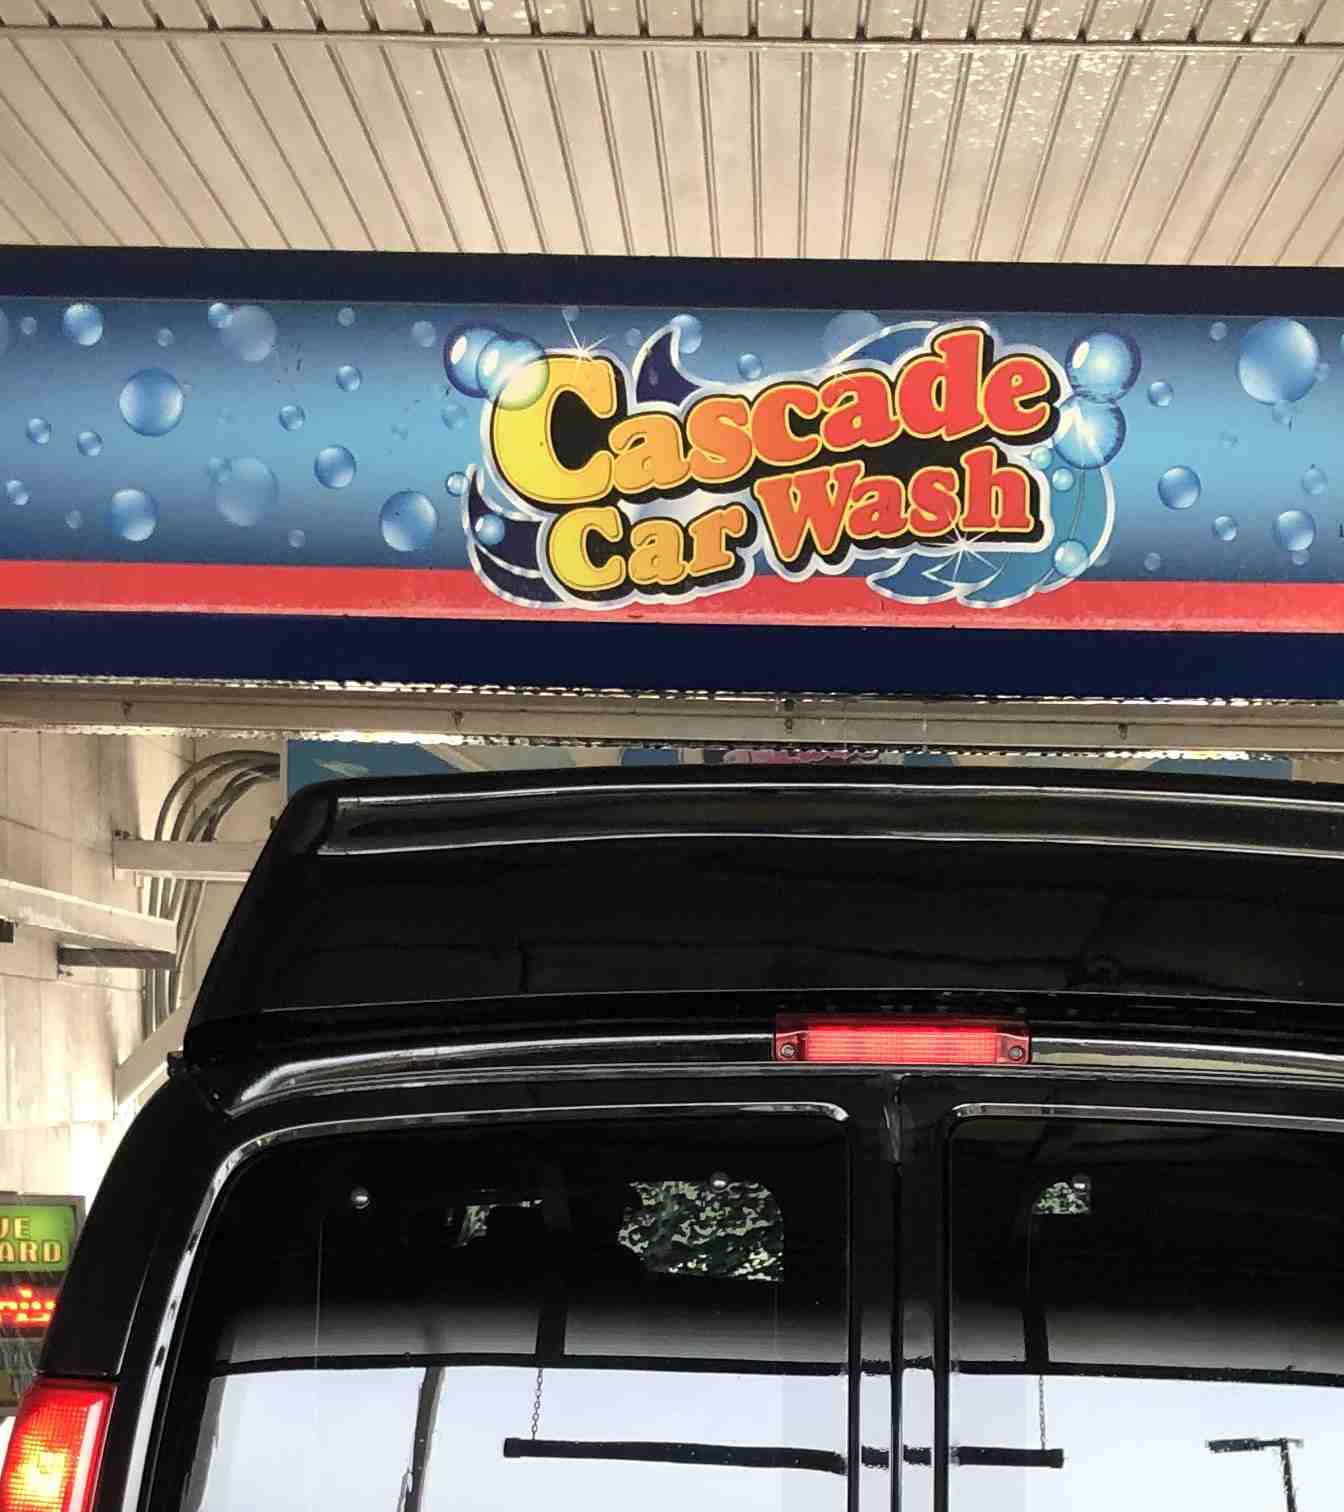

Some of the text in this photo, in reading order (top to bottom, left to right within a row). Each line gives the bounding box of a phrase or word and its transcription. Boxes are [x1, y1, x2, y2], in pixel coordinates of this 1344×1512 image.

[491, 328, 1053, 505] Cascade
[547, 444, 1034, 592] Car Wash
